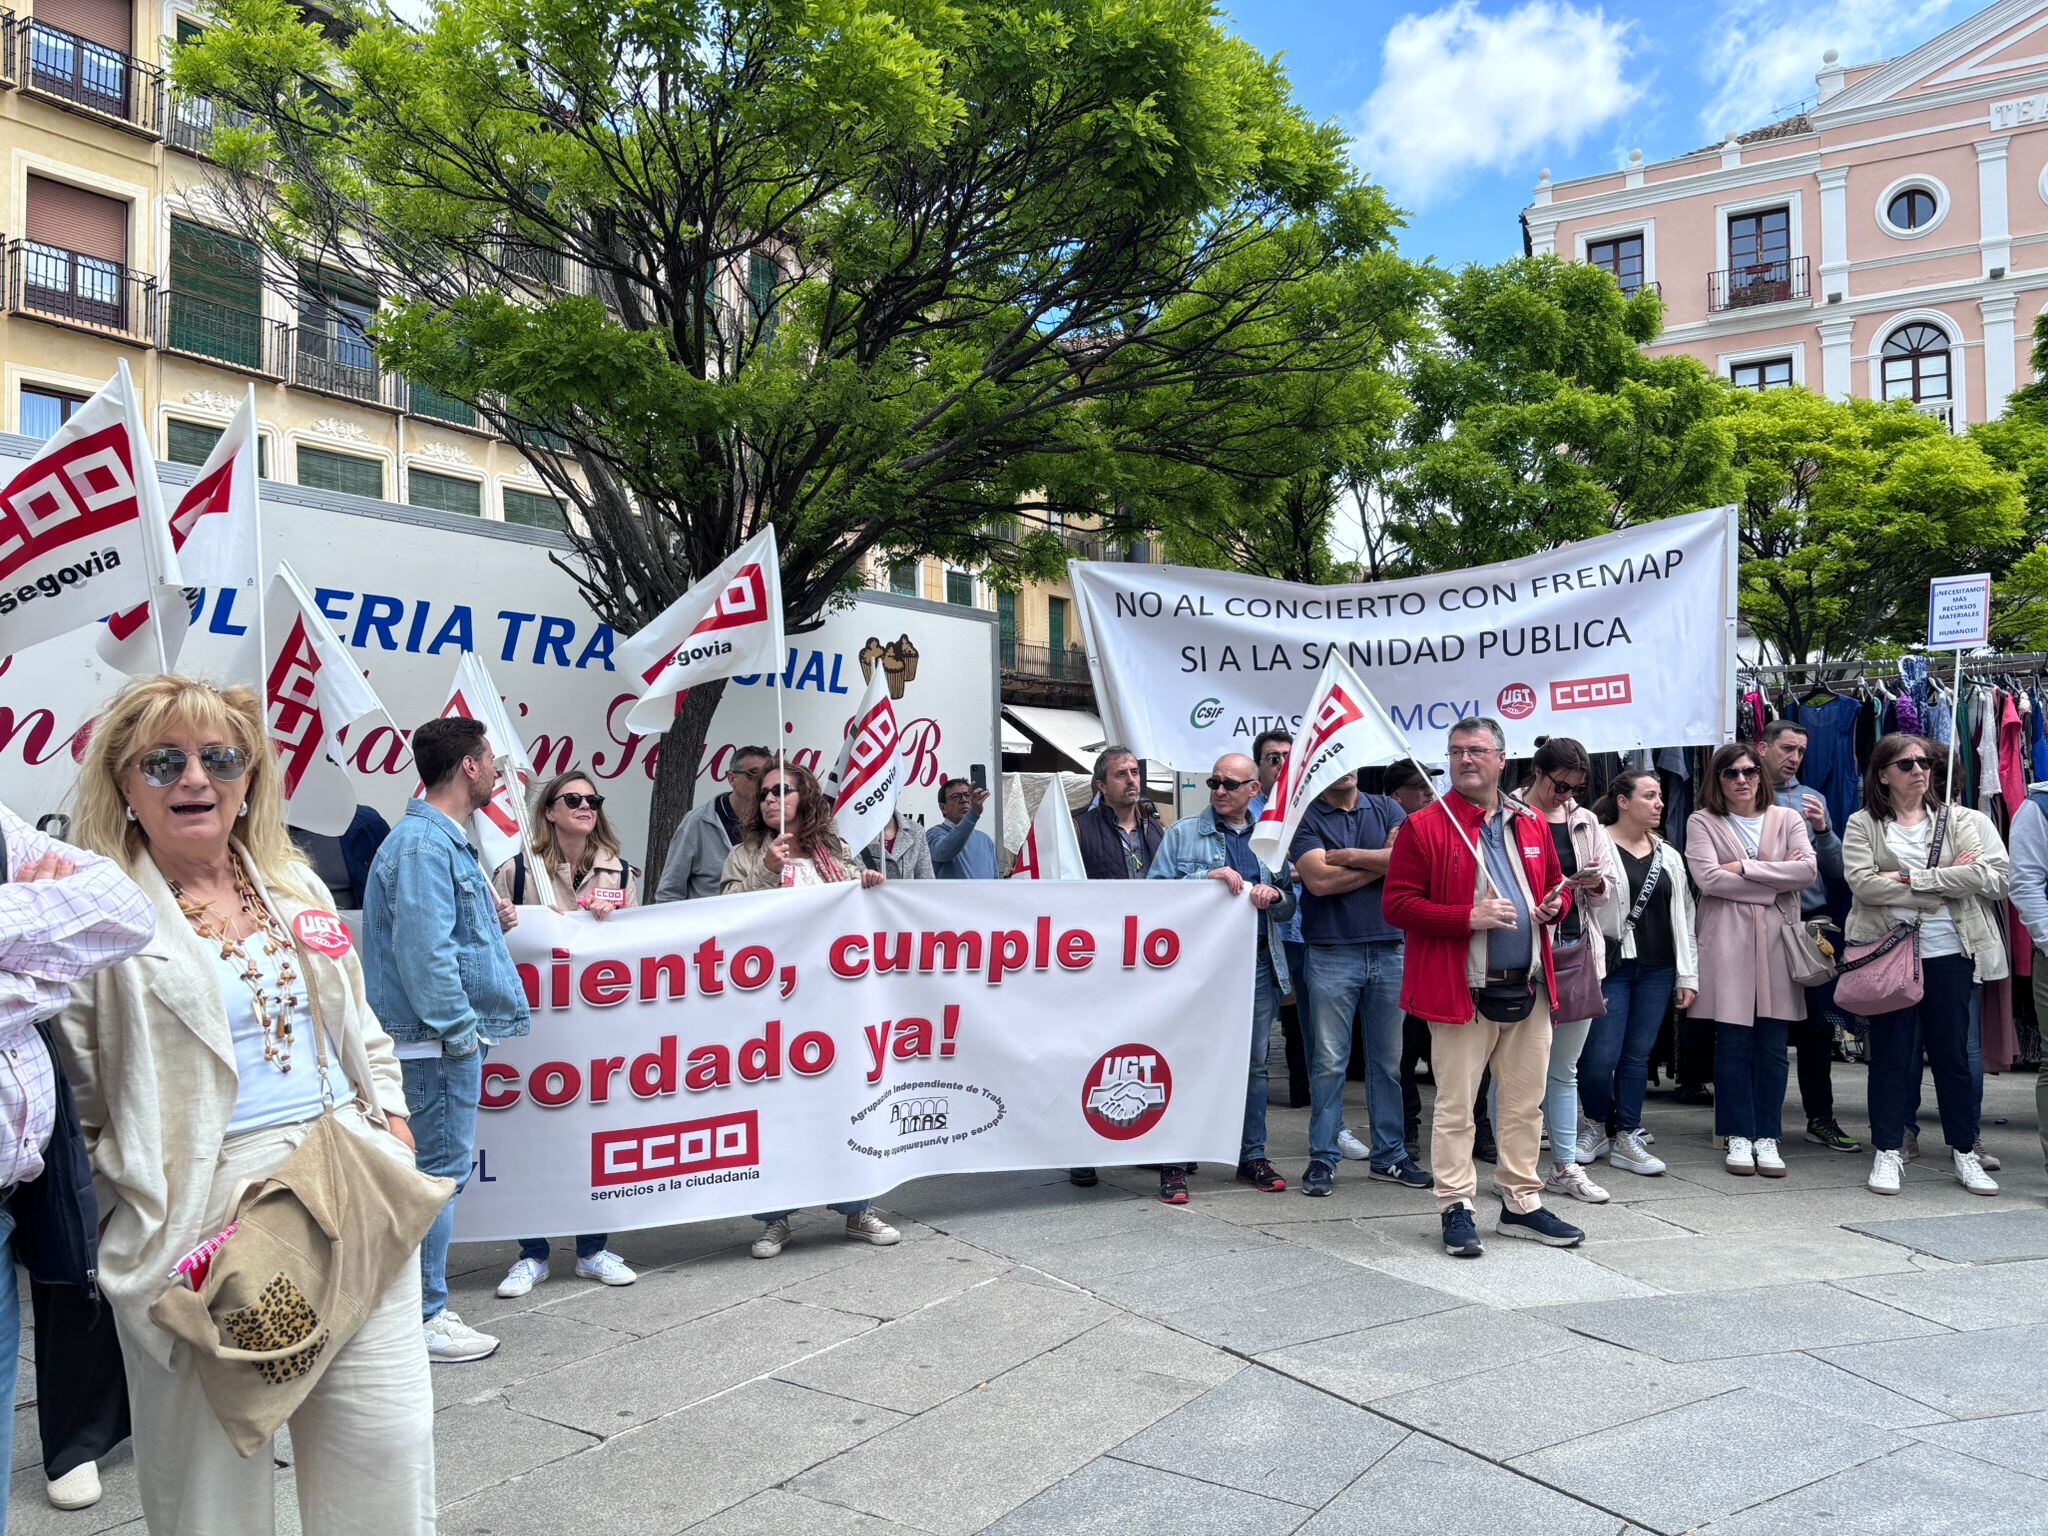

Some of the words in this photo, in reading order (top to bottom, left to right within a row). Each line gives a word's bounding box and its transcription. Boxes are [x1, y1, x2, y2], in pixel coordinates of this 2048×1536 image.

[1115, 592, 1162, 618] NO
[1173, 593, 1214, 617] AL
[1225, 592, 1426, 620] CONCIERTO
[1438, 582, 1517, 611] CON
[1531, 549, 1684, 598] FREMAP
[1939, 611, 1979, 620] MATERIALES
[1942, 603, 1977, 611] RECURSOS
[97, 587, 473, 655] LERIA
[1939, 628, 1978, 636] HUMANOS!!
[666, 640, 732, 666] egovia
[1181, 646, 1206, 673] SI
[1219, 645, 1241, 672] A
[1252, 644, 1292, 671] LA
[1479, 617, 1632, 659] PUBLICA
[1502, 689, 1530, 704] UGT
[1556, 681, 1625, 704] CCOO
[1197, 707, 1224, 718] CSIF
[1232, 715, 1303, 737] AITAS
[597, 891, 621, 899] CCOO
[300, 914, 341, 935] UGT
[829, 915, 1096, 984] cumple
[1122, 915, 1182, 968] lo
[477, 1019, 836, 1109] cordado
[864, 1004, 961, 1085] ya!
[1102, 1055, 1157, 1083] UGT
[893, 1080, 963, 1094] Independiente
[965, 1084, 979, 1094] de
[971, 1088, 1007, 1136] Trabajadores
[891, 1136, 949, 1156] Ayuntamiento
[952, 1132, 968, 1142] del
[604, 1122, 747, 1174] CCOO
[847, 1138, 882, 1158] Segovia
[591, 1183, 654, 1201] servicios
[658, 1182, 667, 1192] a
[670, 1178, 682, 1190] la
[685, 1168, 760, 1188] ciudadanía
